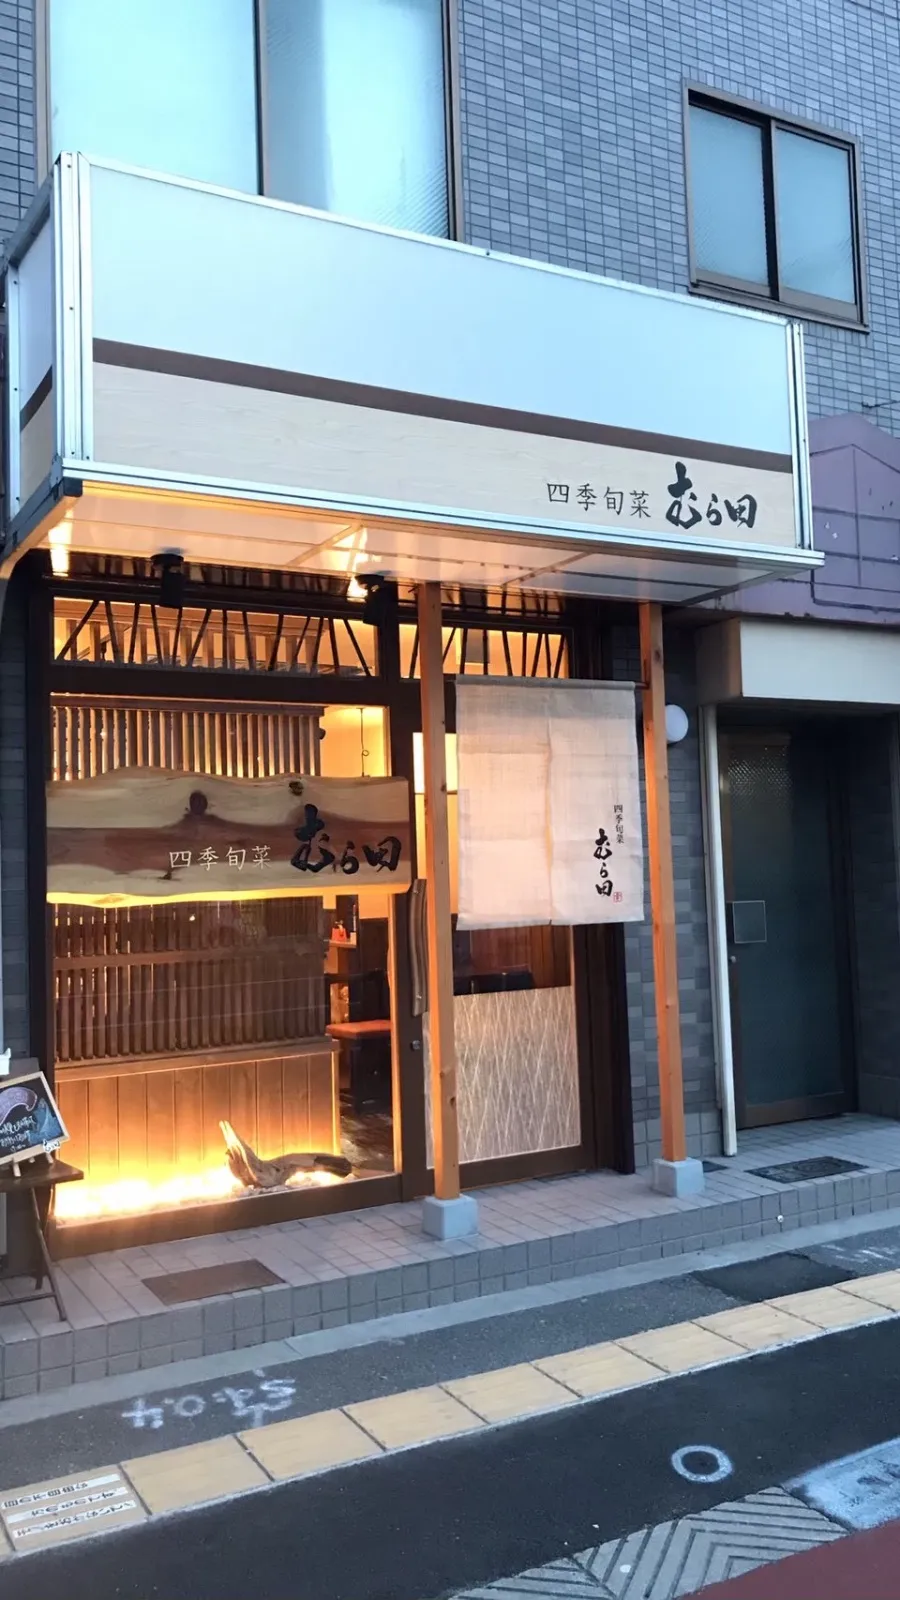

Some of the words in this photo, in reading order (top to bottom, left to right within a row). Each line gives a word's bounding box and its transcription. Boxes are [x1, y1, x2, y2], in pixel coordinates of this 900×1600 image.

[546, 482, 652, 518] 四季旬菜
[665, 461, 758, 530] むら田
[169, 845, 273, 872] 四季旬菜
[290, 803, 403, 875] むら田
[613, 804, 624, 844] 四季旬菜
[593, 828, 613, 897] むら田
